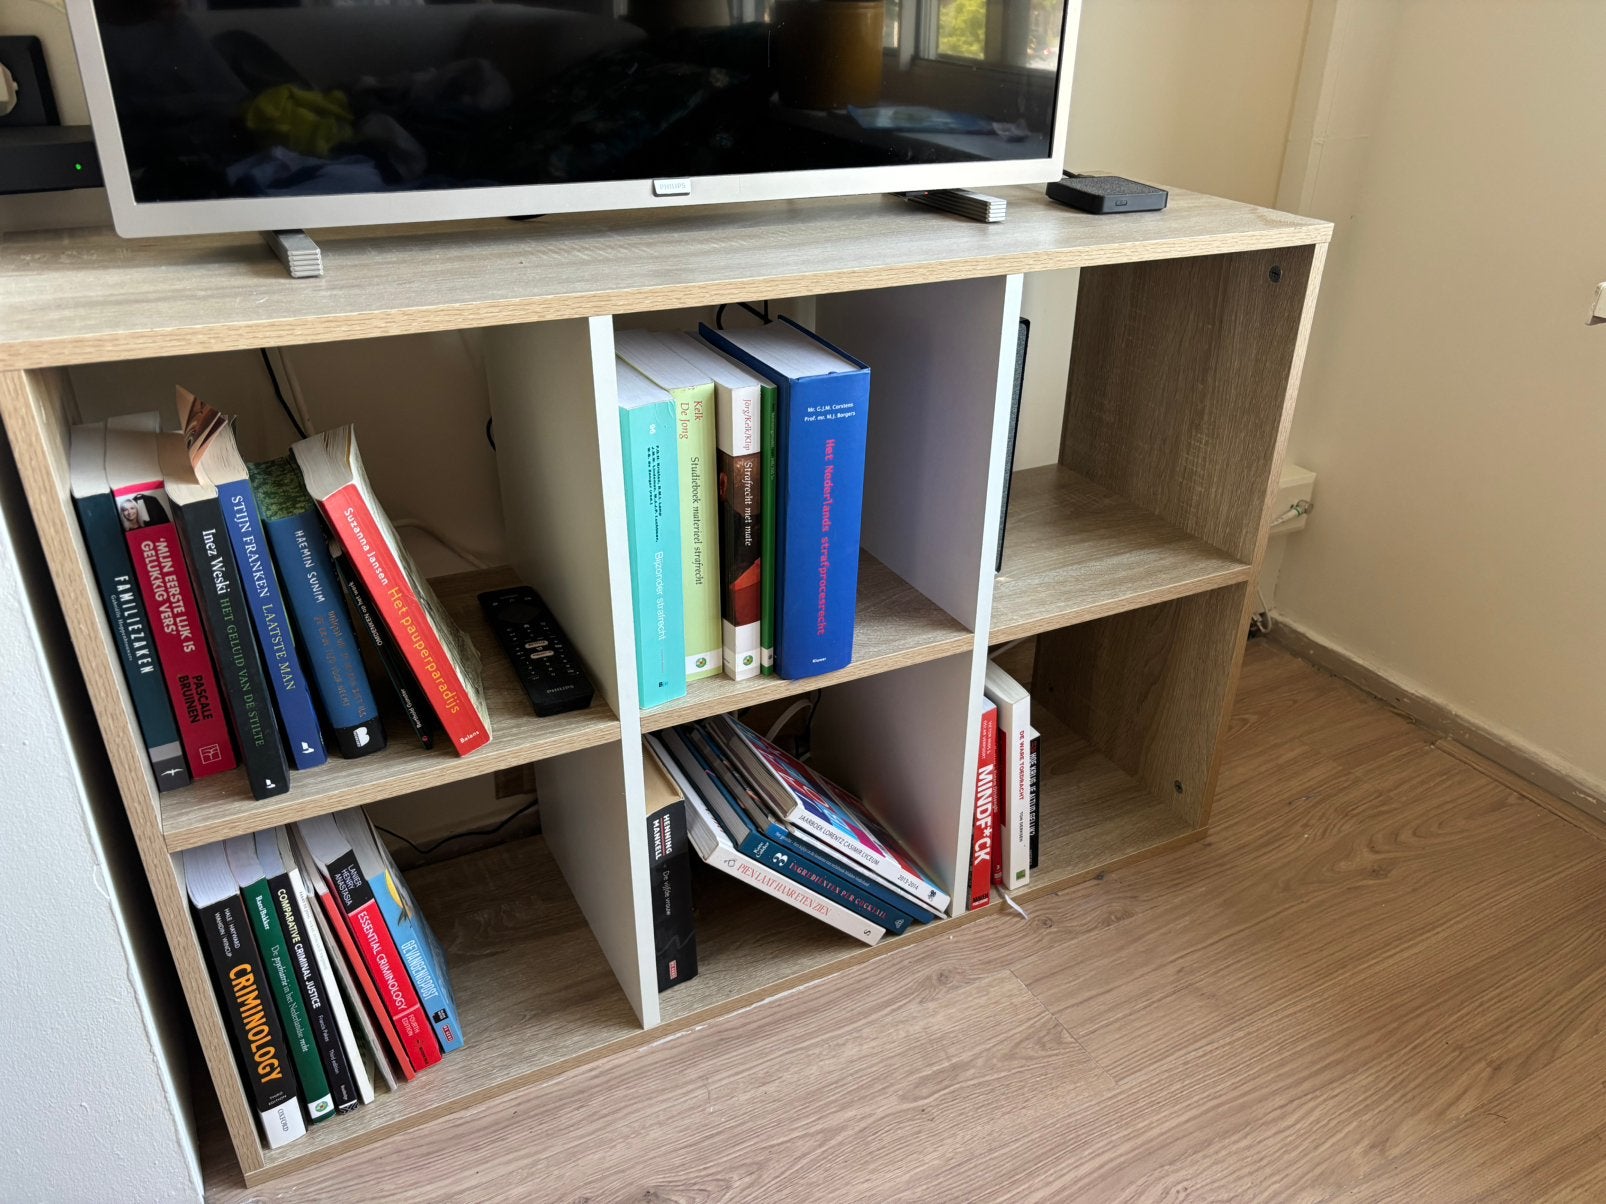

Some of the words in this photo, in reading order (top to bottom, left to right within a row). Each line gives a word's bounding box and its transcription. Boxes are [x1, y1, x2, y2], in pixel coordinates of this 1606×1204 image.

[679, 402, 689, 415] De
[693, 400, 703, 421] Kelk
[836, 409, 855, 419] Borgers
[678, 418, 690, 439] Jong
[825, 439, 835, 459] Het
[690, 456, 701, 503] Studieboek
[742, 462, 752, 504] Strafrecht
[821, 465, 834, 532] Nederlands
[692, 506, 702, 544] materieel
[744, 508, 752, 523] met
[200, 527, 221, 557] Inez
[744, 526, 752, 546] mate
[139, 539, 167, 601] GELUKKIG
[208, 557, 230, 594] Weski
[294, 530, 314, 568] HAEMIN
[307, 571, 325, 603] SUNIM
[653, 551, 664, 594] Bijzonder
[692, 547, 704, 585] strafrecht
[164, 574, 184, 614] EERSTE
[230, 494, 251, 533] STIJN
[241, 534, 270, 599] FRANKEN
[261, 602, 287, 660] LAATSTE
[277, 660, 296, 691] MAN
[355, 594, 364, 605] het
[816, 537, 830, 635] strafprocesrecht
[114, 574, 153, 673] FAMILIEZAKEN
[218, 598, 234, 621] HET
[342, 506, 372, 551] Suzanna
[366, 551, 390, 586] Jansen
[386, 586, 409, 614] Het
[399, 614, 462, 715] pauperparadijs
[360, 604, 369, 612] op
[656, 598, 666, 640] strafrecht
[175, 615, 191, 640] LIJK
[363, 612, 383, 646] OMDENKEN
[182, 640, 195, 653] IS
[224, 624, 245, 667] GELUID
[236, 669, 251, 691] VAN
[178, 674, 200, 724] BRUINEN
[192, 673, 213, 721] PASCALE
[242, 694, 255, 709] DE
[246, 710, 264, 747] STILTE
[459, 729, 480, 744] Balans
[1019, 730, 1024, 740] DE
[652, 819, 662, 859] MANKELL
[663, 814, 672, 854] HENNING
[798, 813, 823, 832] JAARBOEK
[821, 827, 844, 844] LORENTZ
[842, 840, 862, 855] CASIMIR
[860, 851, 880, 866] LYCEUM
[333, 873, 353, 906] ANASTASIA
[340, 868, 355, 890] HENRY
[346, 863, 363, 888] LANIER
[661, 881, 670, 897] vijfde
[663, 870, 670, 880] De
[736, 862, 758, 879] PIEN
[812, 901, 831, 917] ZIEN
[896, 873, 919, 890] 2013-2014
[223, 907, 232, 921] HALE
[228, 924, 240, 948] HAYWARD
[221, 937, 232, 958] WINCUP
[270, 944, 281, 956] De
[276, 888, 301, 943] COMPARATIVE
[293, 943, 312, 980] CRIMINAL
[305, 979, 321, 1008] JUSTICE
[356, 910, 382, 955] ESSENTIAL
[375, 952, 407, 1011] CRIMINOLOGY
[271, 955, 289, 986] psychiatrie
[400, 939, 439, 1001] GEVANGENISPOST
[282, 985, 291, 993] in
[285, 992, 294, 1002] het
[227, 961, 282, 1082] CRIMINOLOGY
[287, 1002, 306, 1038] Nederlandse
[401, 1017, 414, 1036] EDITION
[407, 1013, 420, 1033] FOURTH
[299, 1037, 310, 1052] recht
[276, 1108, 289, 1132] OXFORD
